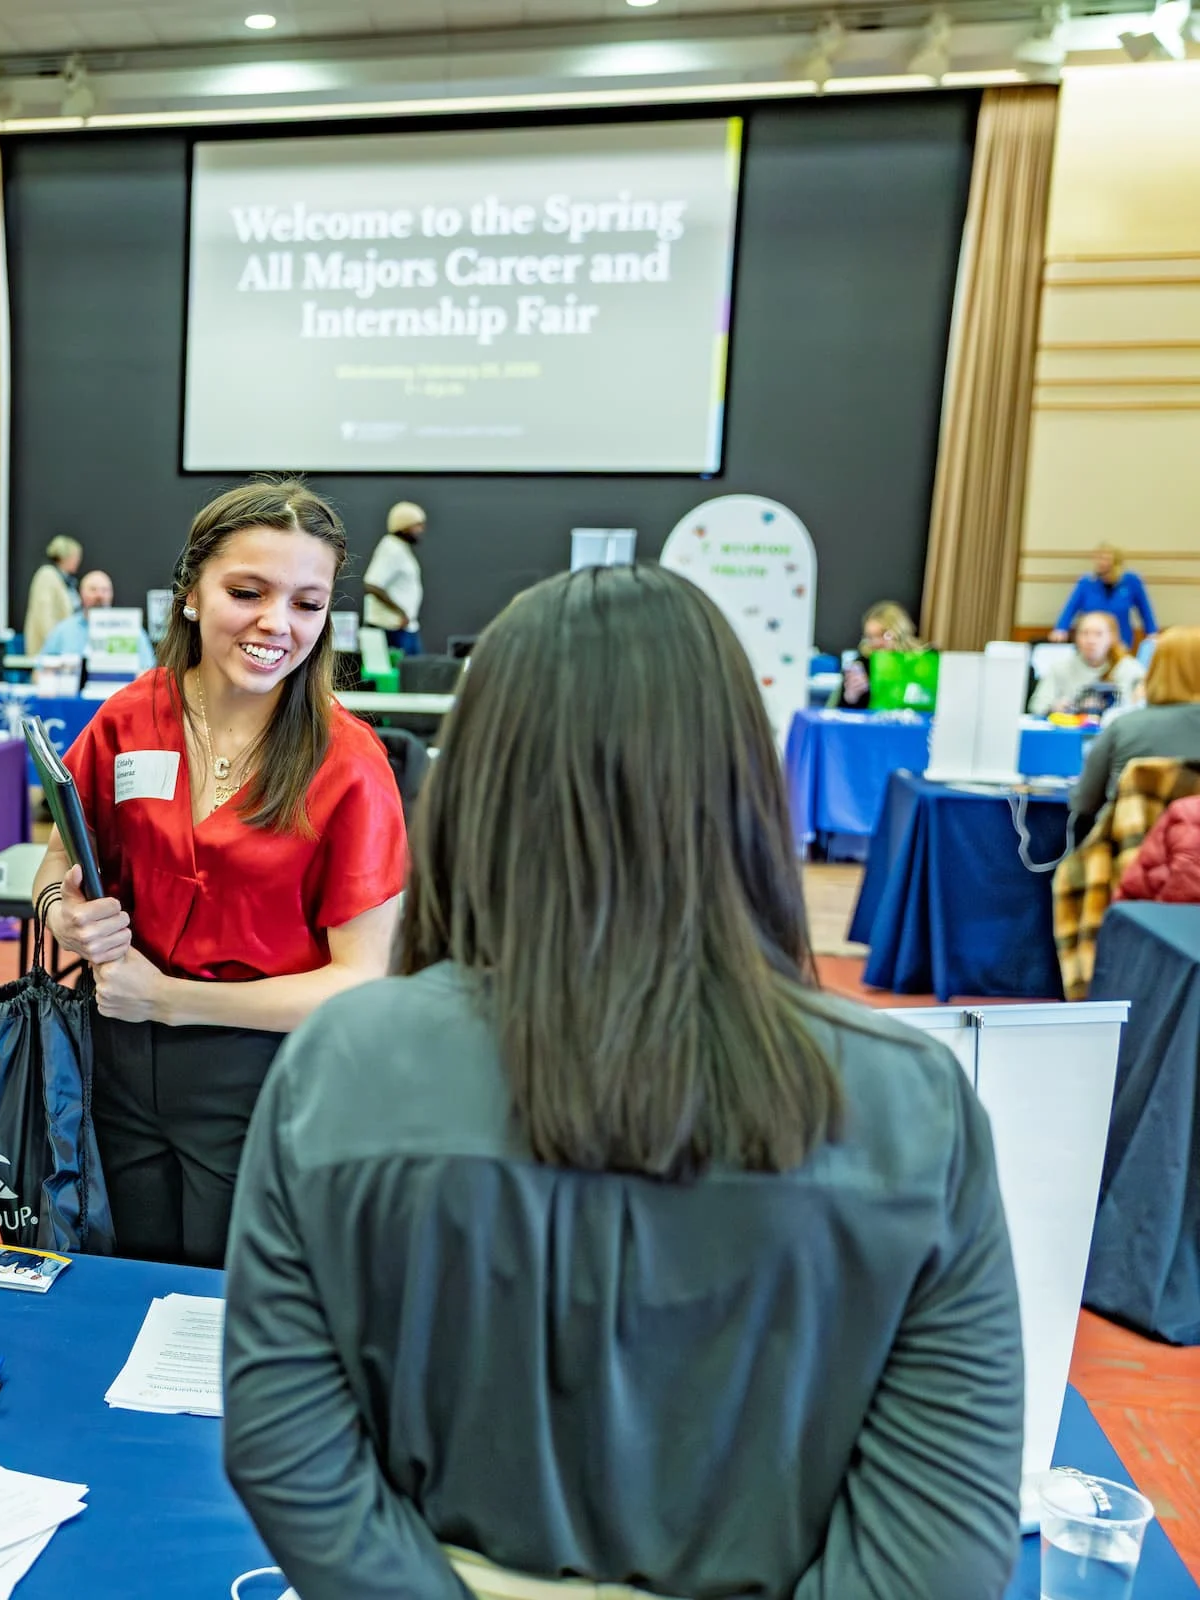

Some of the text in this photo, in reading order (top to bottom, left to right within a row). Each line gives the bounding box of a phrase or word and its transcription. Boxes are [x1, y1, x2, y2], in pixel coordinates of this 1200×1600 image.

[231, 191, 687, 244] Welcome to the Spring
[237, 241, 670, 299] All Majors Career and
[299, 294, 599, 345] Internship Fair
